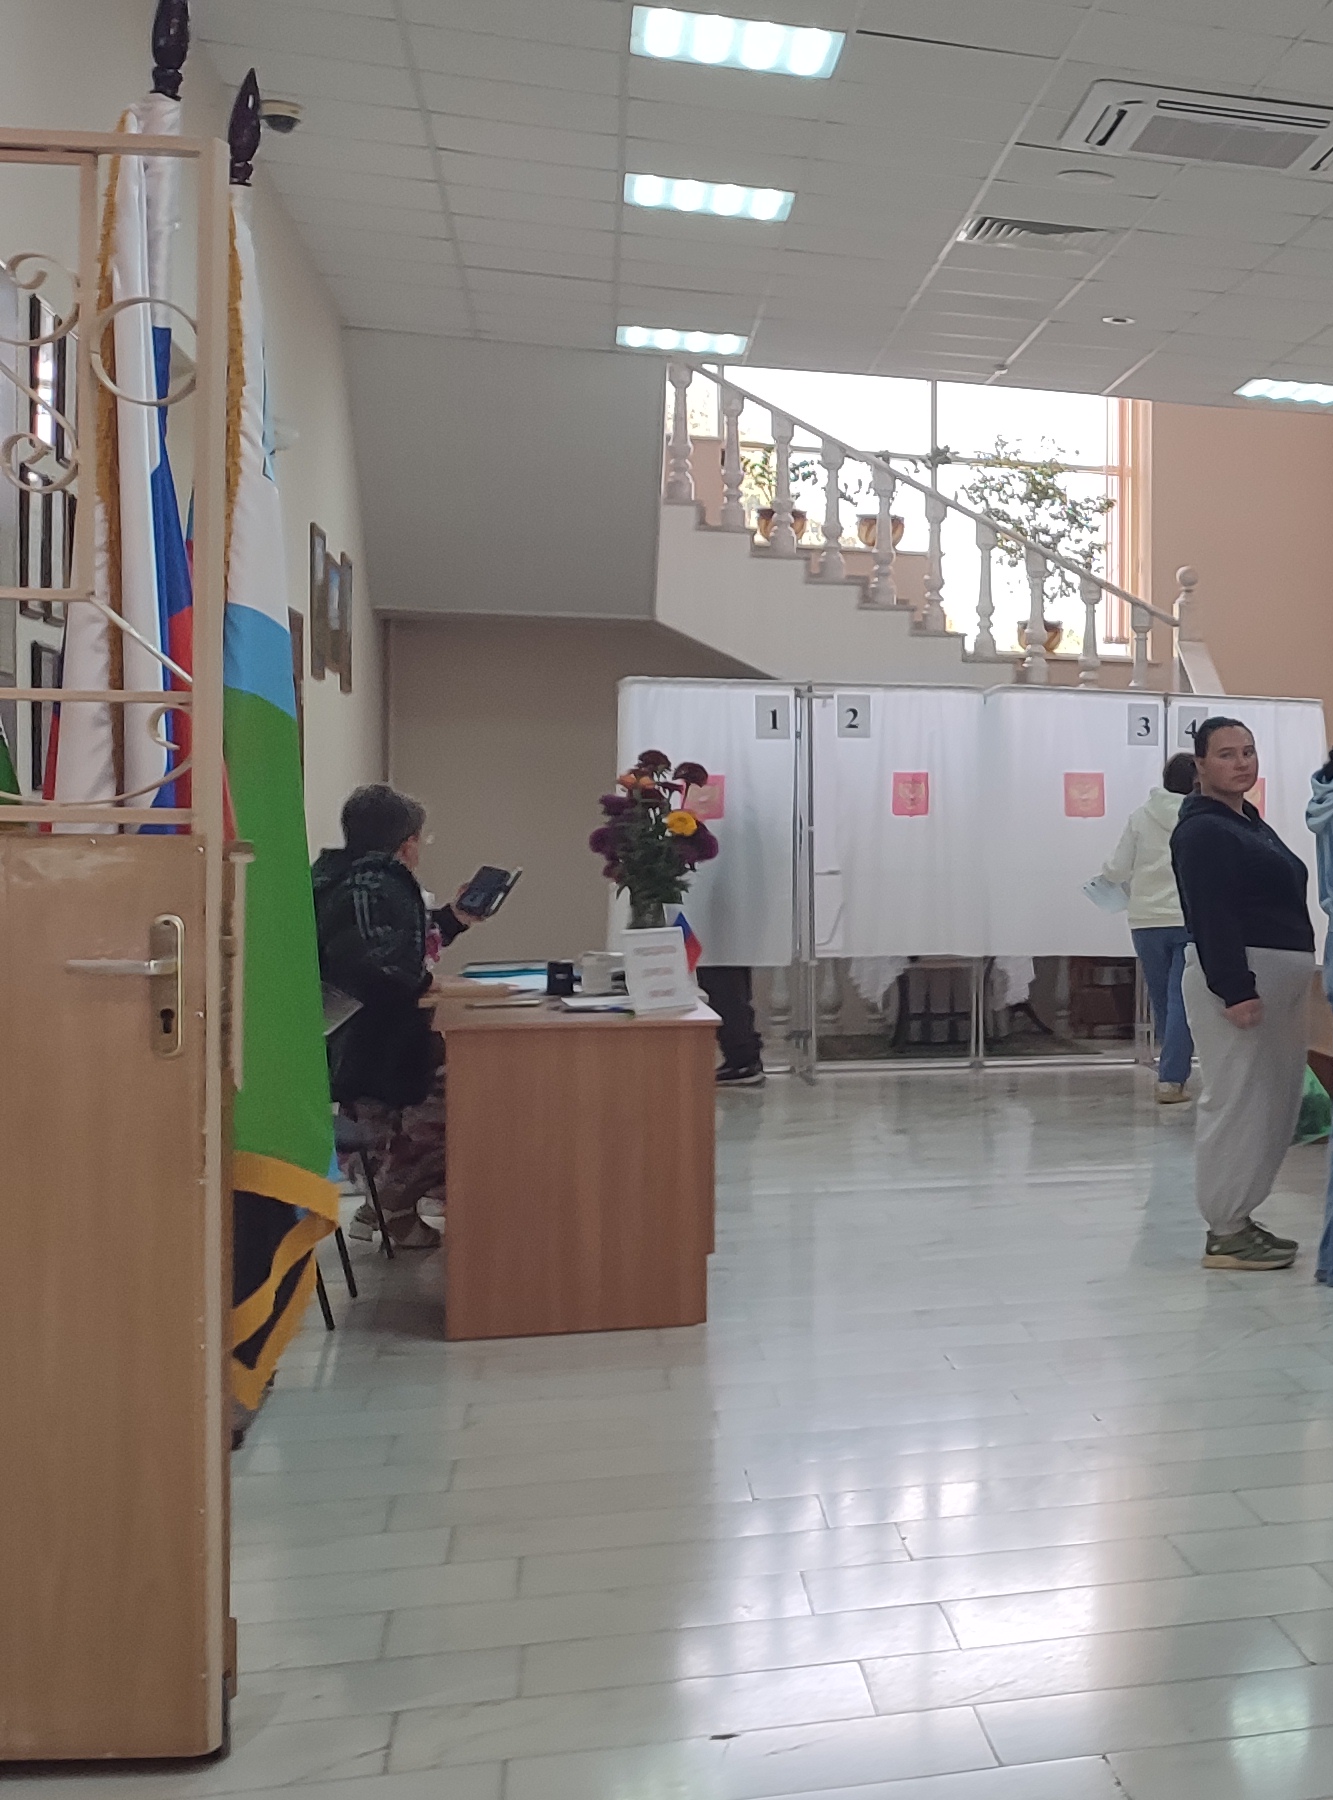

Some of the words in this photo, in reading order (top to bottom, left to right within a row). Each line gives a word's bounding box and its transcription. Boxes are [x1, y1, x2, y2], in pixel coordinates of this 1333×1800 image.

[770, 708, 778, 730] 1
[845, 707, 859, 729] 2
[1136, 716, 1151, 737] 3
